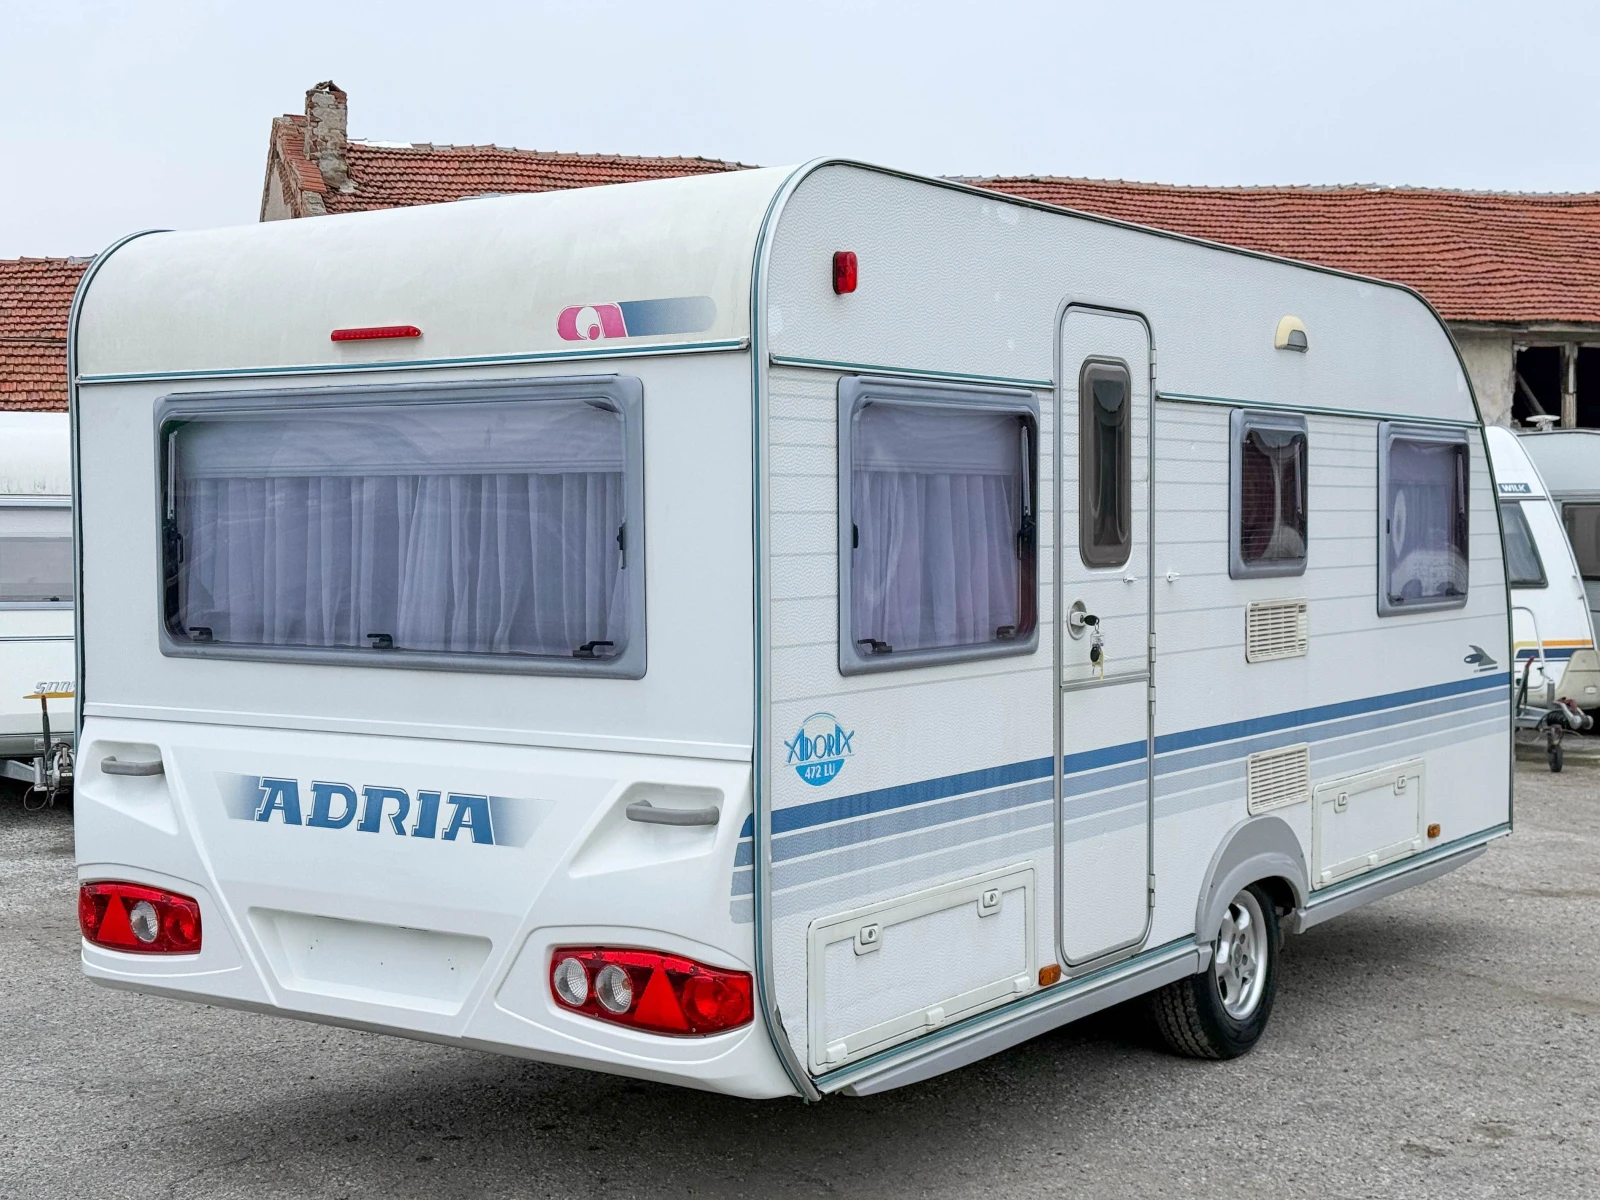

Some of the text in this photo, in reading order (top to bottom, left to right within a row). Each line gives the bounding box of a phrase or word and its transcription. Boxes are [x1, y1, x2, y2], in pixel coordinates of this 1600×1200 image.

[1501, 484, 1526, 493] WILK
[804, 763, 836, 779] 472 LU
[255, 776, 494, 845] ADRIA
